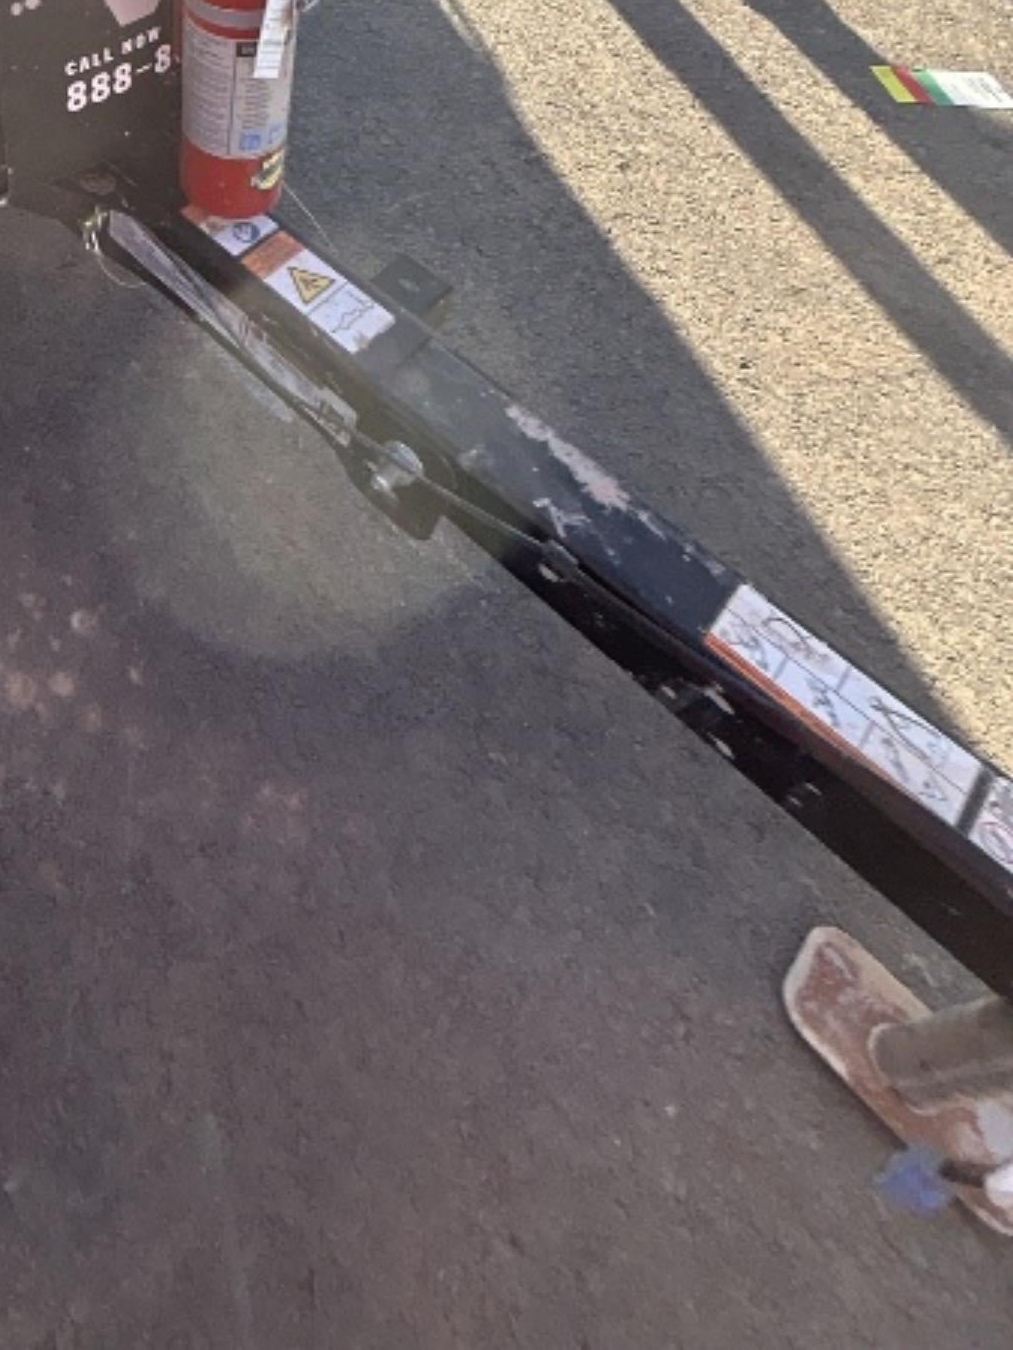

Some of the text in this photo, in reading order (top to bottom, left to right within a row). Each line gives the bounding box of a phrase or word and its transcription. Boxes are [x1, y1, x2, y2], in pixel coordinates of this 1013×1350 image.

[64, 26, 162, 76] CALL NOW
[67, 44, 180, 112] 888-8
